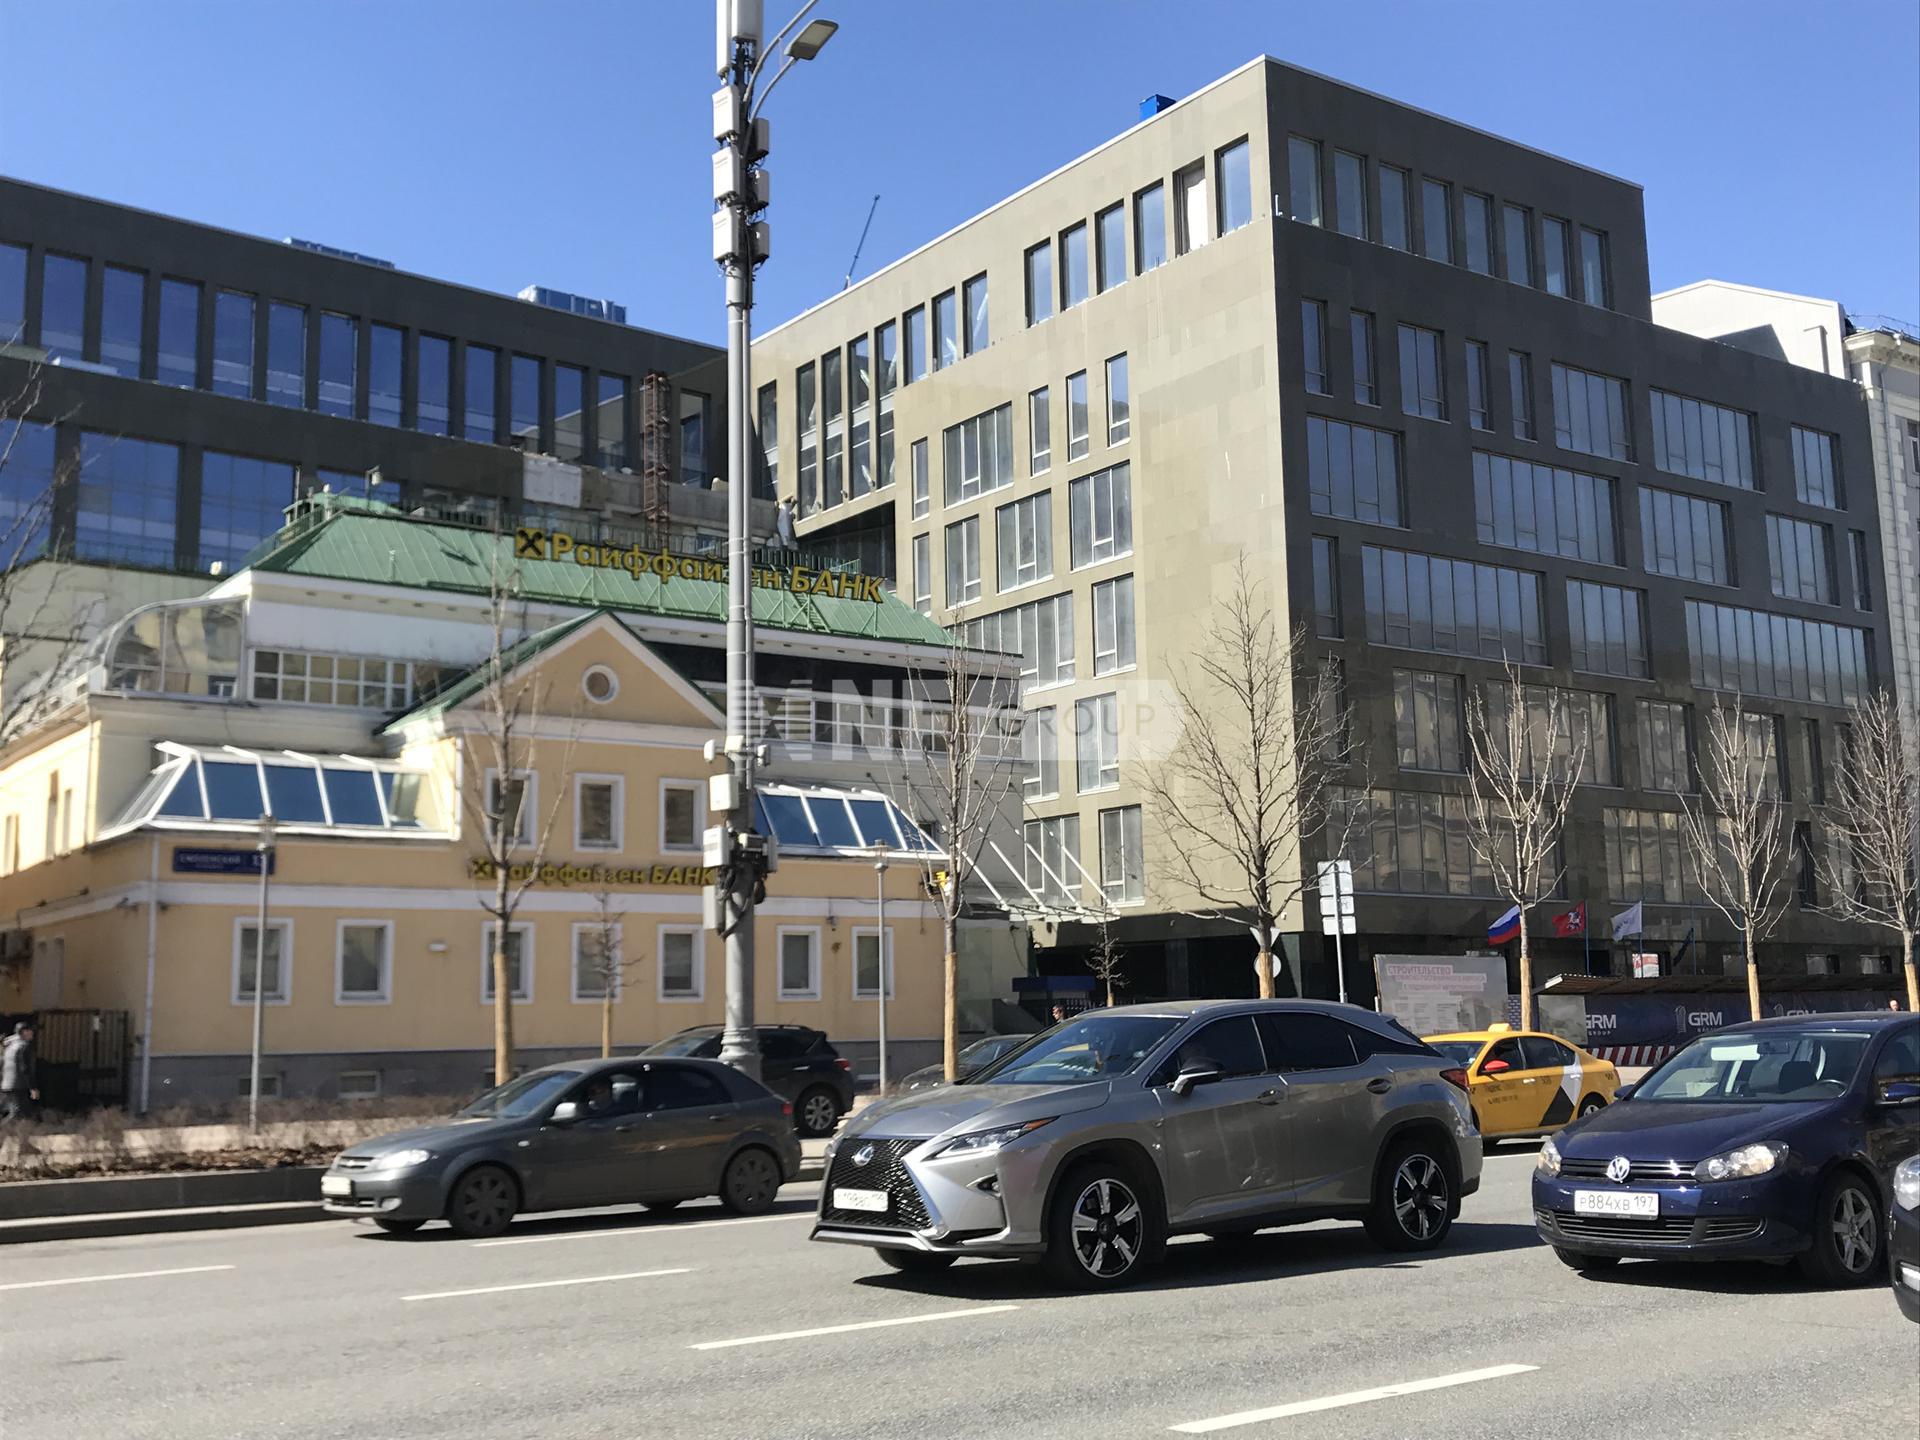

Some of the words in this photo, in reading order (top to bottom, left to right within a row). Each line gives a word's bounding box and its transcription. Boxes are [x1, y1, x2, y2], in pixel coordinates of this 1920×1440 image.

[552, 532, 781, 590] Райффайн
[790, 566, 885, 603] БАНК
[494, 862, 646, 886] аффазен
[649, 864, 717, 886] БАНК
[1687, 1011, 1722, 1026] GRM
